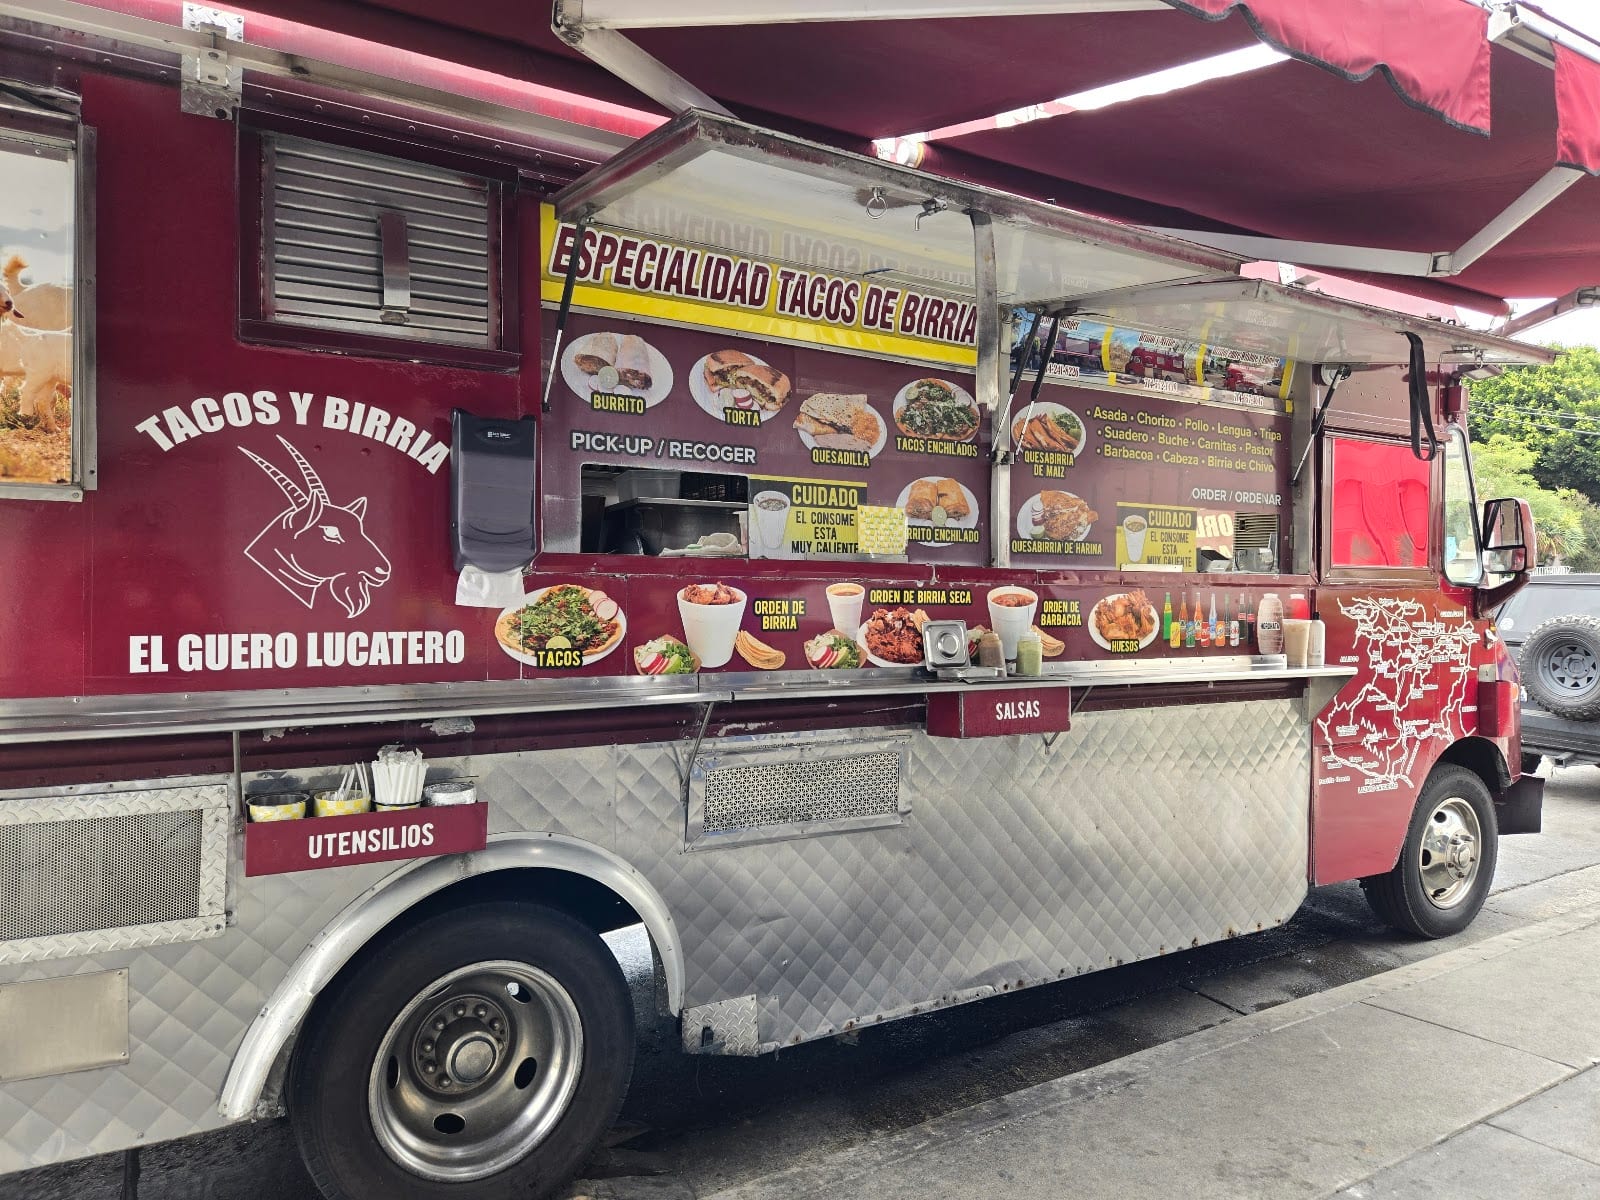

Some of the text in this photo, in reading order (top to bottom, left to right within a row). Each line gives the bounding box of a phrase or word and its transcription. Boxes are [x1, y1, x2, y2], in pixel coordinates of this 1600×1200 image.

[551, 224, 770, 308] ESPECIALIDAD
[778, 269, 859, 325] TACOS
[863, 286, 900, 331] DE
[900, 293, 977, 344] BIRRIA
[593, 394, 644, 414] BURRITO
[725, 409, 760, 427] TORTA
[1093, 407, 1282, 442] Asada Chorizo Pollo Lengua Tripa
[135, 390, 450, 475] TACOS Y BIRRIA
[1104, 426, 1274, 456] Suadero Buche Carnitas Pastor
[572, 432, 653, 455] PICK-UP
[669, 441, 757, 463] RECOGER
[896, 436, 978, 457] TACOS ENCHILADOS
[812, 449, 870, 467] QUESADILLA
[1024, 451, 1074, 466] QUESABIRRIA
[1104, 444, 1274, 472] Barbacoa Cabeza Birria de Chivo
[1034, 465, 1065, 477] DE MAIZ
[792, 485, 858, 508] CUIDADO
[1192, 487, 1227, 502] ORDER
[1234, 491, 1282, 506] ORDENAR
[796, 510, 855, 526] EL CONSOME
[1148, 510, 1192, 528] CUIDADO
[814, 527, 837, 540] ESTA
[908, 527, 979, 542] RRITO ENCHILADO
[1150, 531, 1189, 543] EL CONSOME
[792, 541, 812, 553] MUY
[1012, 540, 1102, 555] QUESABIRRIA DE HARINA
[1162, 544, 1178, 555] ESTA
[870, 589, 972, 605] ORDEN DE BIRRIA SECA
[755, 599, 805, 616] ORDEN DE
[1043, 600, 1080, 614] ORDEN DE
[762, 614, 798, 631] BIRRIA
[1041, 613, 1082, 627] BARBACOA
[129, 629, 465, 674] EL GUERO LUCATERO
[1111, 639, 1139, 653] HUESOS
[537, 650, 581, 667] TACOS
[995, 700, 1040, 721] SALSAS
[308, 822, 434, 859] UTENSILIOS
